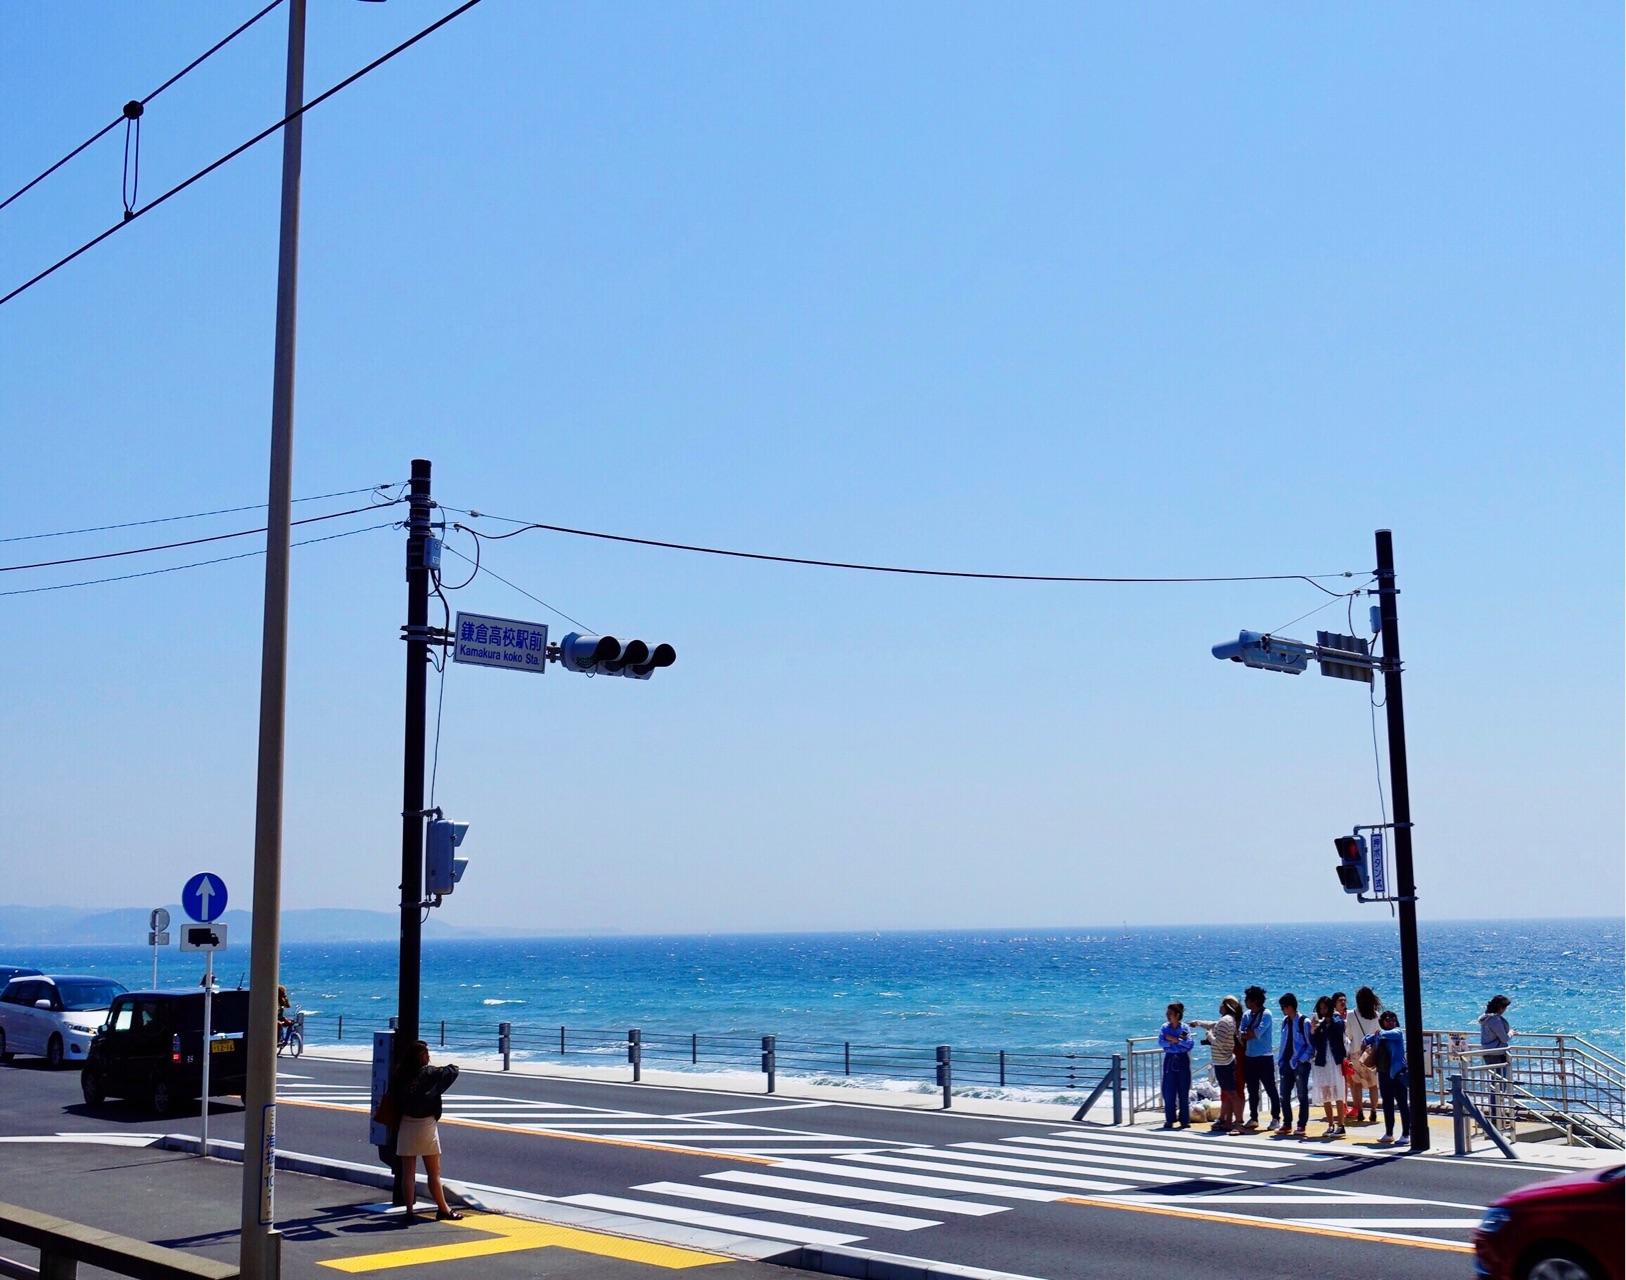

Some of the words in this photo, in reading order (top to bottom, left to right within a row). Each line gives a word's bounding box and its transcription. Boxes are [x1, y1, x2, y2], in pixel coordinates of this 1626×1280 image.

[460, 621, 543, 652] 鎌倉高校駅前
[460, 644, 501, 660] Kamakura
[503, 650, 523, 663] koko
